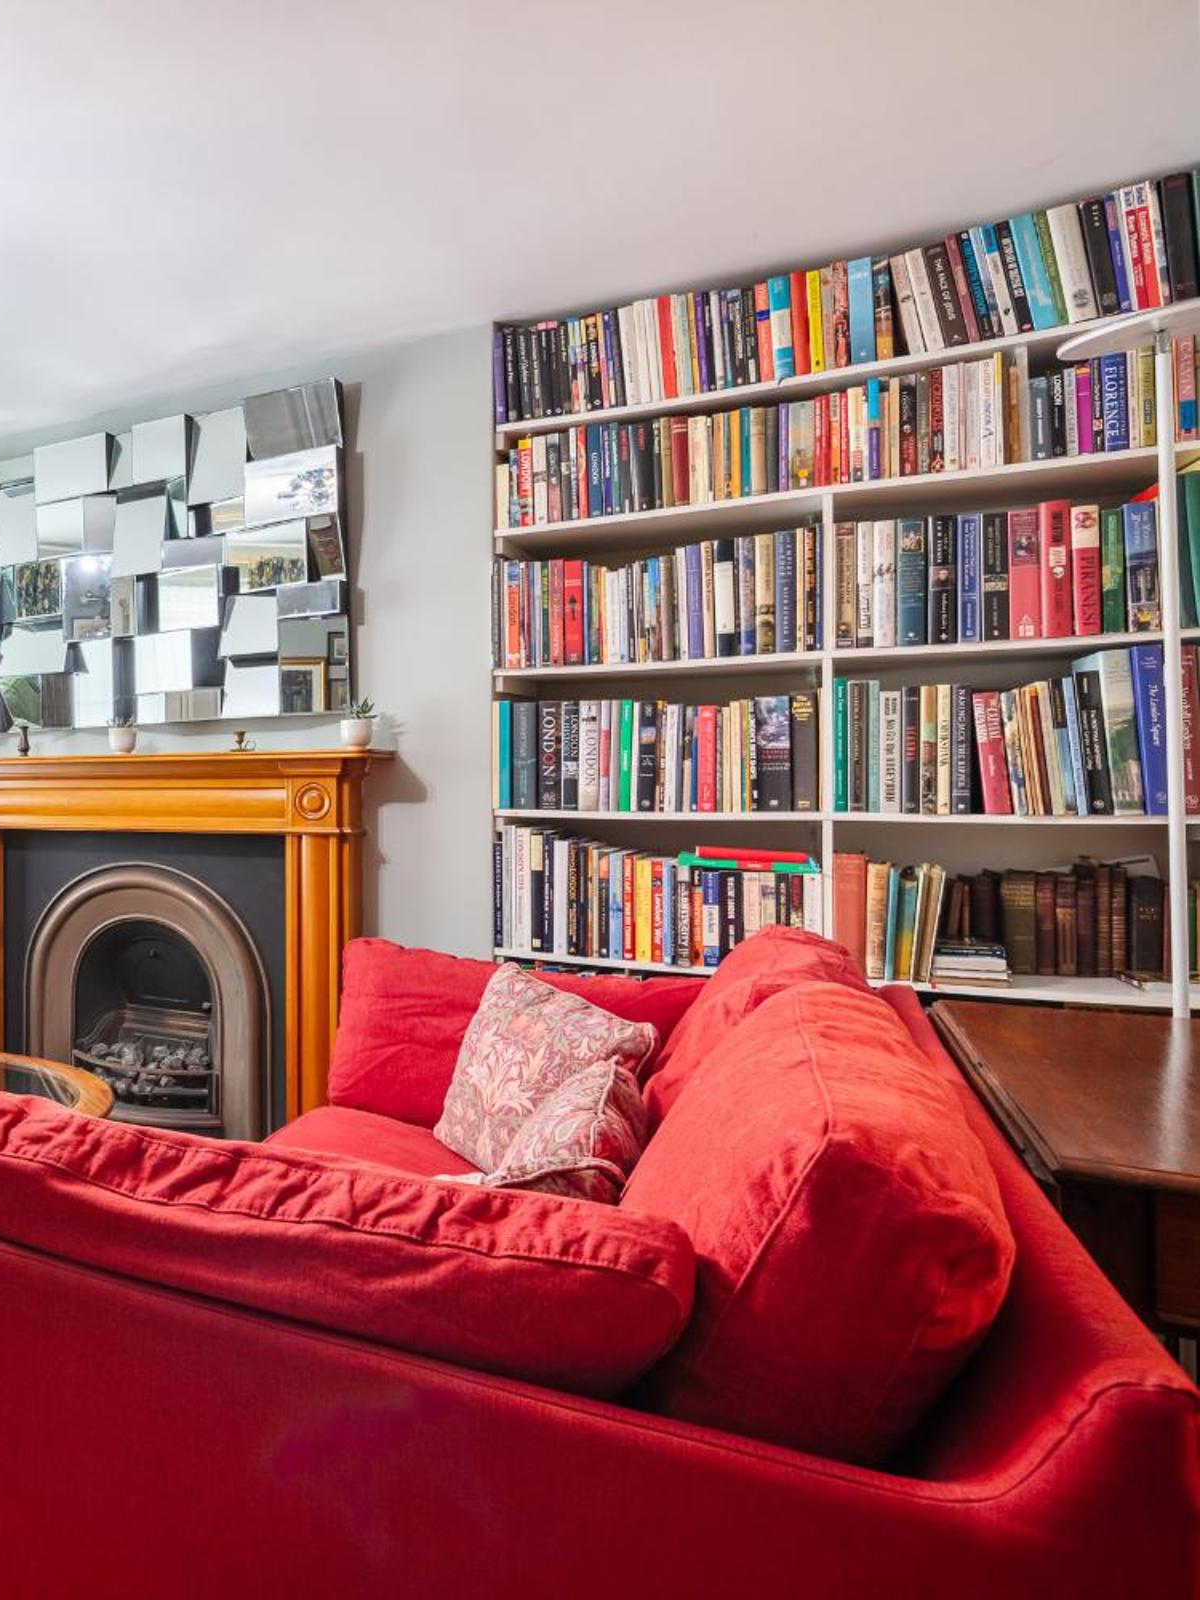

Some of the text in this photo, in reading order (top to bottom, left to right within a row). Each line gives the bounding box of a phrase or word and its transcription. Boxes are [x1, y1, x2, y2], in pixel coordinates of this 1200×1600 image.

[1104, 366, 1119, 437] FLORENCE
[521, 451, 531, 489] LONDON
[591, 452, 599, 485] LONDON
[1080, 555, 1098, 626] PIRANESI
[542, 707, 555, 777] LONDON
[570, 714, 578, 757] LONDON
[1148, 684, 1161, 746] The London Square
[585, 729, 597, 786] LONDON
